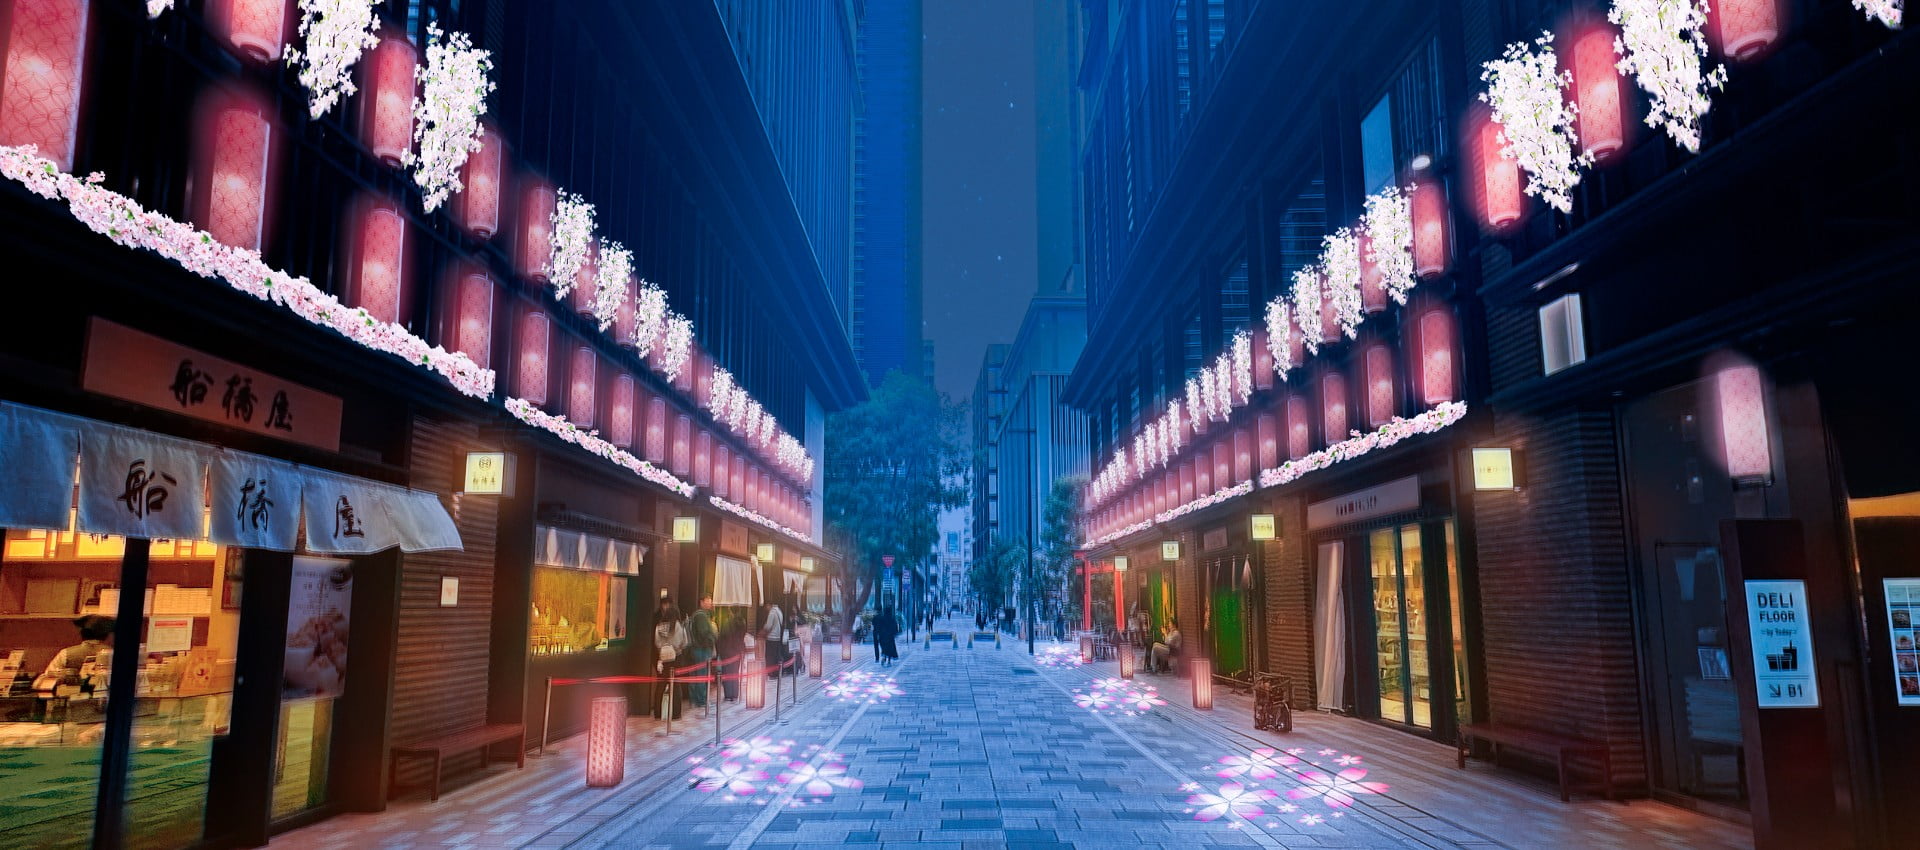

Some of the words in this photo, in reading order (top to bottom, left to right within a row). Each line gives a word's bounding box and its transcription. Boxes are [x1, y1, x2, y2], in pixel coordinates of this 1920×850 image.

[169, 359, 293, 432] 船橋屋
[1757, 592, 1794, 609] DELI
[1760, 611, 1796, 623] FLOOR
[1788, 684, 1803, 698] B1
